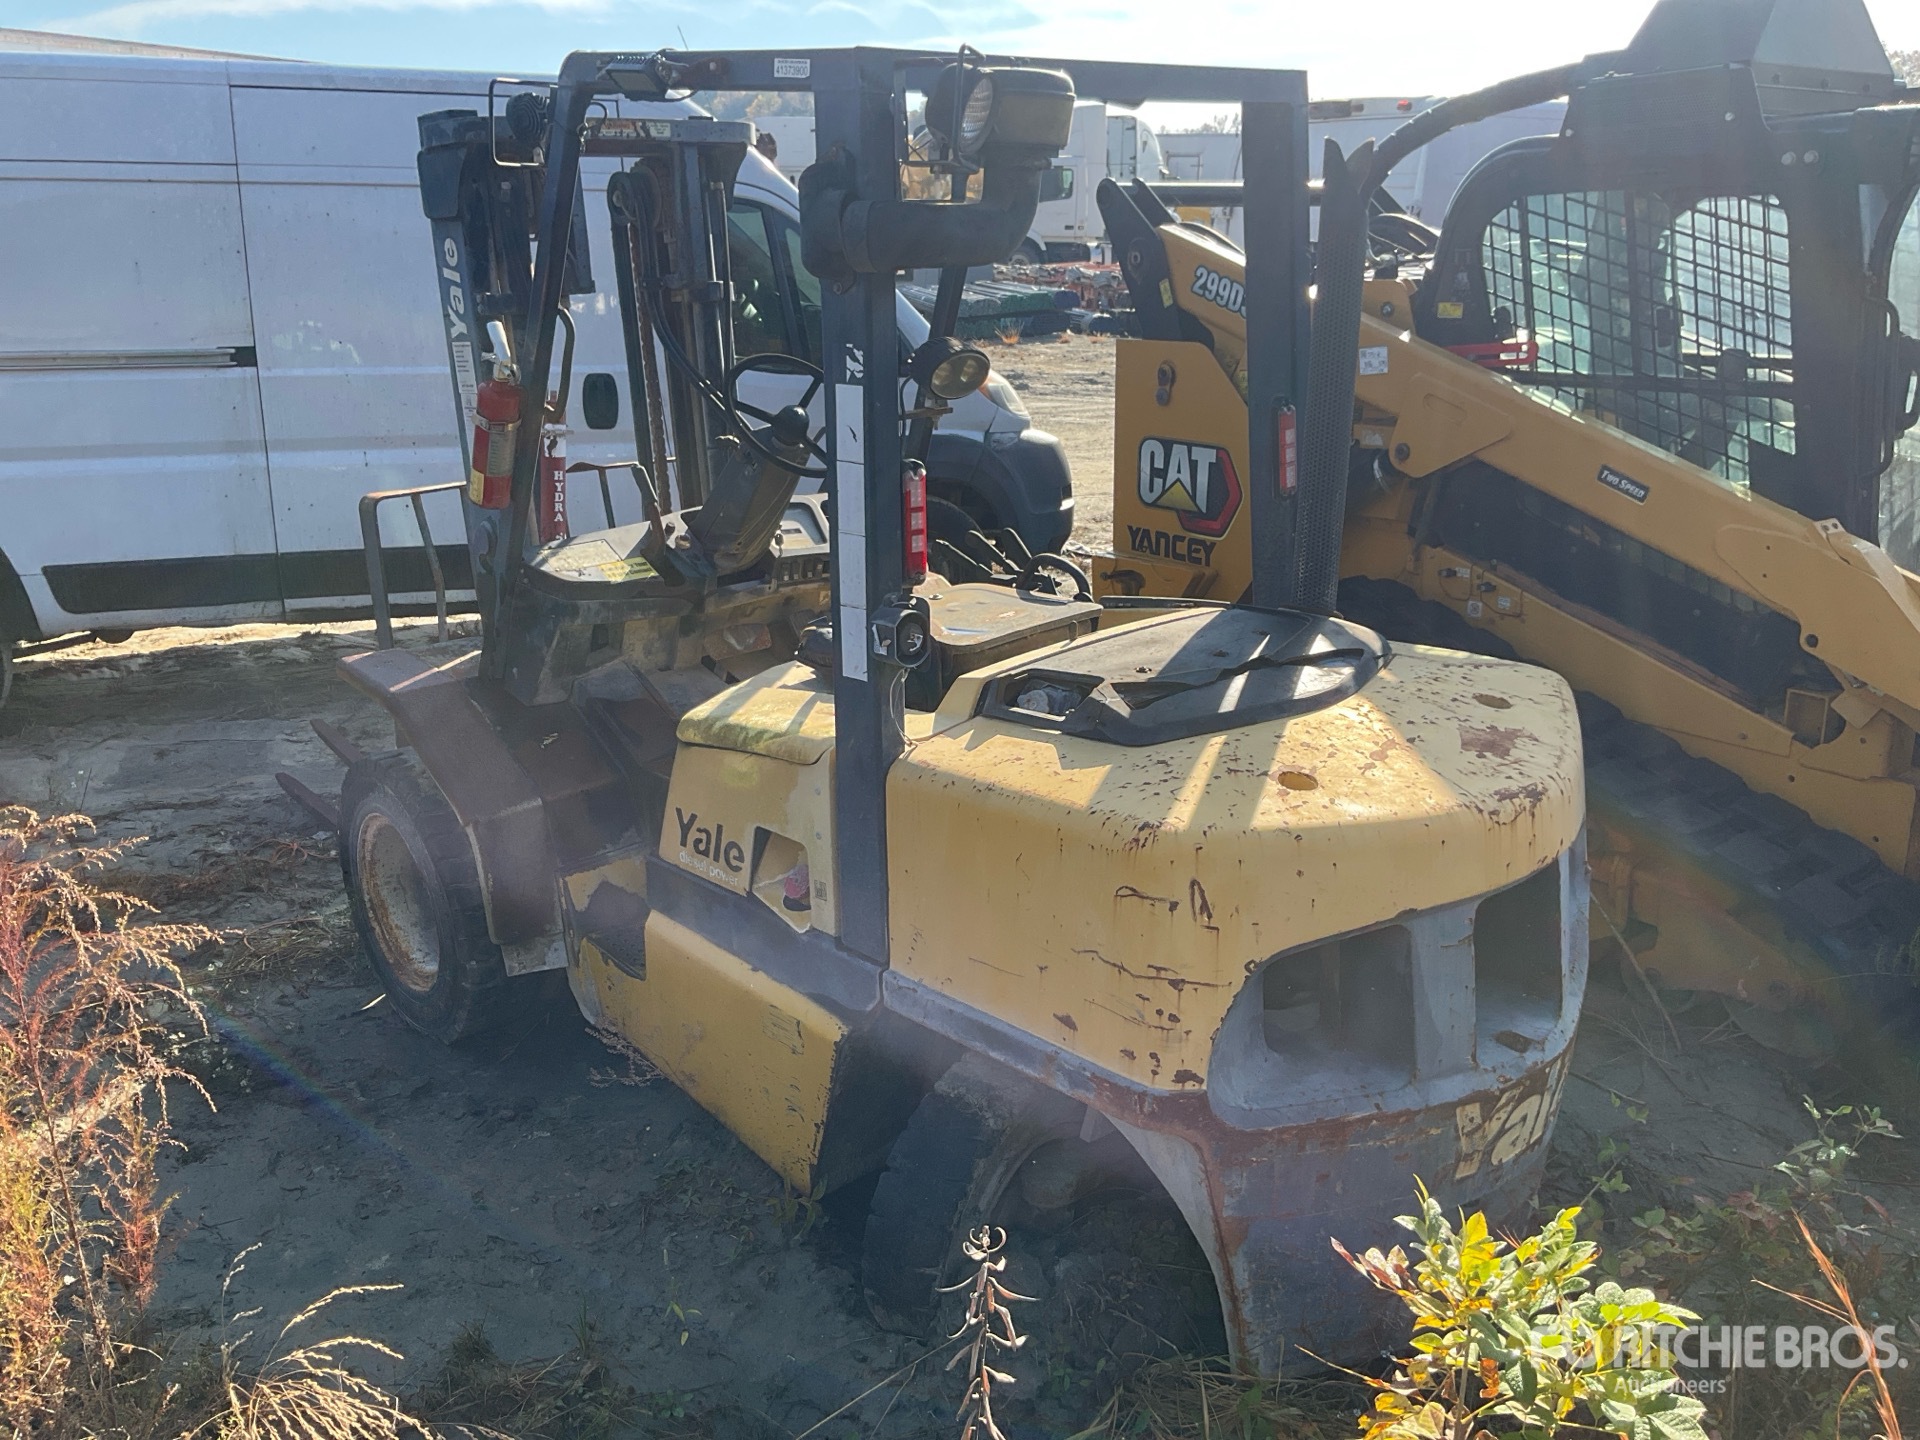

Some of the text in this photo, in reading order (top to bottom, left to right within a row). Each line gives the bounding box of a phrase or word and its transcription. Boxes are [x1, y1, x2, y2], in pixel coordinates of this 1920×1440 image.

[443, 237, 468, 339] Yale
[1191, 265, 1246, 318] 299D
[553, 470, 564, 522] HYDRA
[1140, 438, 1216, 515] CAT
[1127, 525, 1217, 567] YANCEY
[675, 806, 745, 873] Yale
